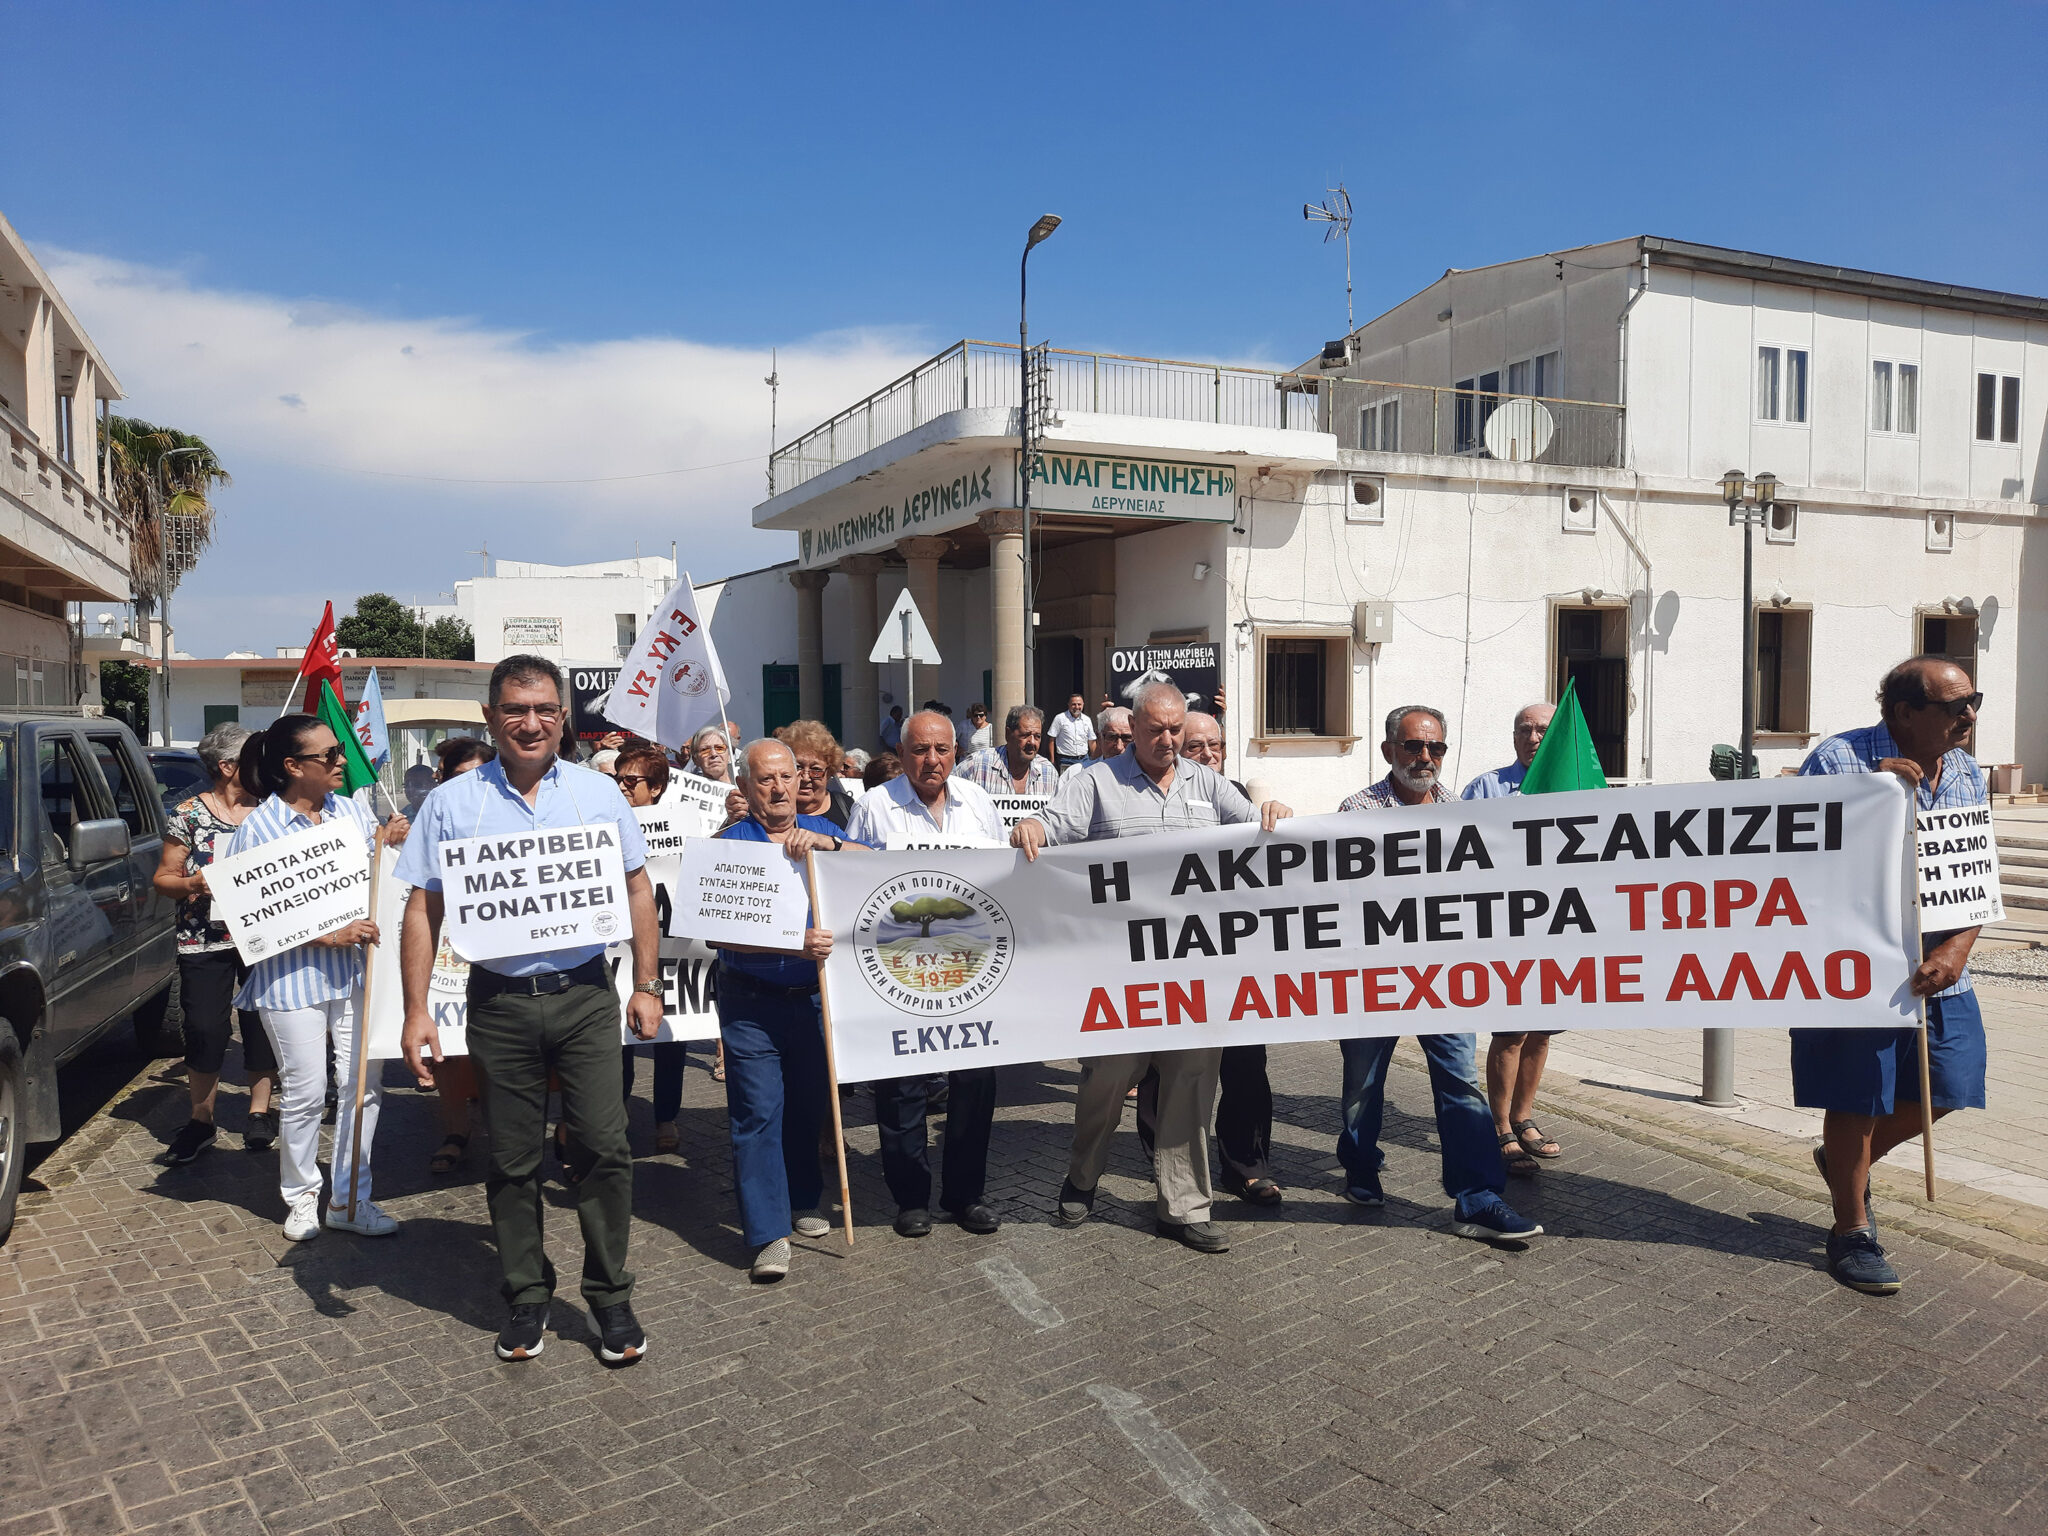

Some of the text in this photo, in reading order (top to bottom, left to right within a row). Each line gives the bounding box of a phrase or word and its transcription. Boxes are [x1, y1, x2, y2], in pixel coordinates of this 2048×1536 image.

[816, 465, 992, 557] ΑΝΑΓΕΝΝΗΣΗ ΔΕΡΥΝΕΙΑΣ
[1092, 496, 1165, 513] ΔΕΡΥΝΕΙΑΣ
[1112, 647, 1215, 672] ΟΧΙ ΣΤΗΝ ΑΚΡΙΒΕΙΑ
[1147, 657, 1216, 670] ΑΙΣΧΡΟΚΕΡΔΕΙΑ
[575, 671, 606, 690] ΟΧΙ
[992, 799, 1048, 810] ΥΠΟΜΟΝ
[445, 829, 615, 867] Η ΑΚΡΙΒΕΙΑ
[647, 836, 683, 849] ΡΓΗΘΕΙ
[1088, 802, 1843, 904] Η ΑΚΡΙΒΕΙΑ ΤΣΑΚΙΖΕΙ
[1918, 835, 1988, 857] ΕΒΑΣΜΟ
[233, 838, 347, 888] ΚΑΤΩ ΤΑ ΧΕΡΙΑ
[714, 863, 766, 877] ΑΠΑΙΤΟΥΜΕ
[1948, 859, 1992, 878] ΤΡΙΤΗ
[260, 860, 339, 899] ΑΠΟ ΤΟΥΣ
[464, 858, 602, 895] ΜΑΣ ΕΧΕΙ
[699, 877, 780, 893] ΣΥΝΤΑΞΗ ΧΗΡΕΙΑΣ
[240, 869, 372, 928] ΣΥΝΤΑΞΙΟΥΧΟΥΣ
[459, 885, 615, 925] ΓΟΝΑΤΙΣΕΙ
[702, 892, 772, 908] ΣΕ ΟΛΟΥΣ ΤΟΥΣ
[860, 877, 1005, 933] ΚΑΛΥΤΕΡΗ ΠΟΙΟΤΗΤΑ ΖΩΗΣ
[1920, 885, 1987, 907] ΗΛΙΚΙΑ
[317, 907, 366, 931] ΔΕΡΥΝΕΙΑΣ
[698, 908, 772, 924] ΑΝΤΡΕΣ ΧΗΡΟΥΣ
[1127, 877, 1808, 962] ΠΑΡΤΕ ΜΕΤΡΑ ΤΩΡΑ
[530, 923, 580, 939] ΕΚΥΣΥ
[862, 936, 1008, 1010] ΕΝΩΣΗ ΚΥΠΡΙΩΝ ΣΥΝΤΑΞΙΟΥΧΩΝ
[917, 969, 964, 987] 1973
[1080, 949, 1872, 1033] ΔΕΝ ΑΝΤΕΧΟΥΜΕ ΑΛΛΟ
[891, 1021, 1000, 1056] Ε.ΚΥ.ΣΥ.
